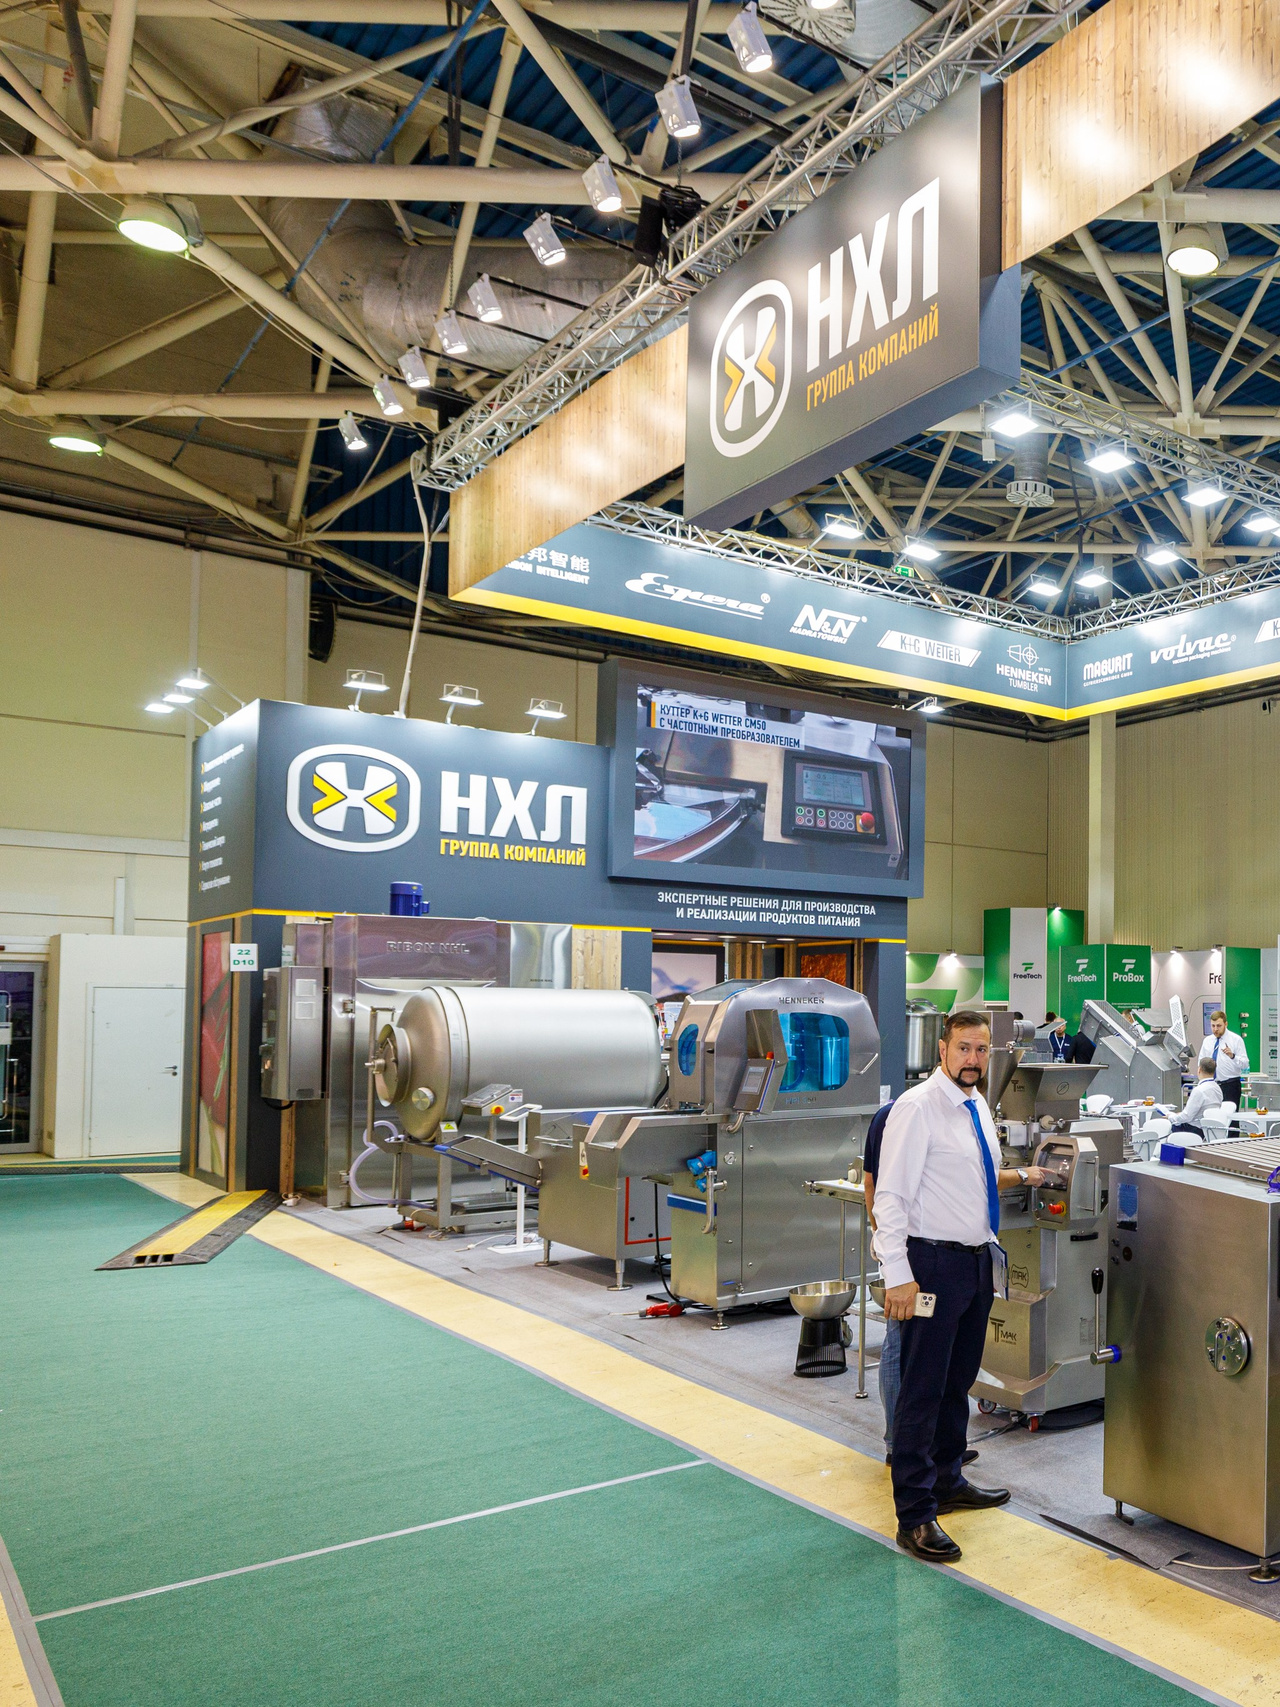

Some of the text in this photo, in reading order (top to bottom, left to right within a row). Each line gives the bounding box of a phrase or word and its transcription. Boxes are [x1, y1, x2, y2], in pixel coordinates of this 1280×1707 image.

[806, 176, 940, 373] НХЛ
[807, 302, 939, 412] ГРУППА КОМПАНИЙ
[520, 547, 590, 573] 邦智能
[536, 565, 590, 585] INTELLIGENT
[789, 626, 849, 645] NADRATOWSKI
[1150, 633, 1232, 664] volvac
[996, 663, 1052, 686] HENNEKEN
[1008, 678, 1039, 692] TUMBLER
[660, 704, 691, 718] КУТТЕР
[711, 713, 743, 726] WETTER
[667, 718, 718, 736] ЧАСТОТНЫМ
[720, 726, 801, 749] ПРЕОБРАЗОВАТЕЛЕМ
[440, 770, 588, 845] НХЛ
[440, 838, 587, 867] ГРУППА КОМПАНИЙ
[657, 892, 876, 916] ЭКСПЕРТНЫЕ РЕШЕНИЯ ДЛЯ ПРОИЗВОДСТВА
[676, 907, 861, 927] И РЕАЛИЗАЦИИ ПРОДУКТОВ ПИТАНИЯ
[386, 940, 470, 954] RIBON NHL
[1067, 973, 1097, 982] FreeTech
[1112, 972, 1145, 982] ProBox
